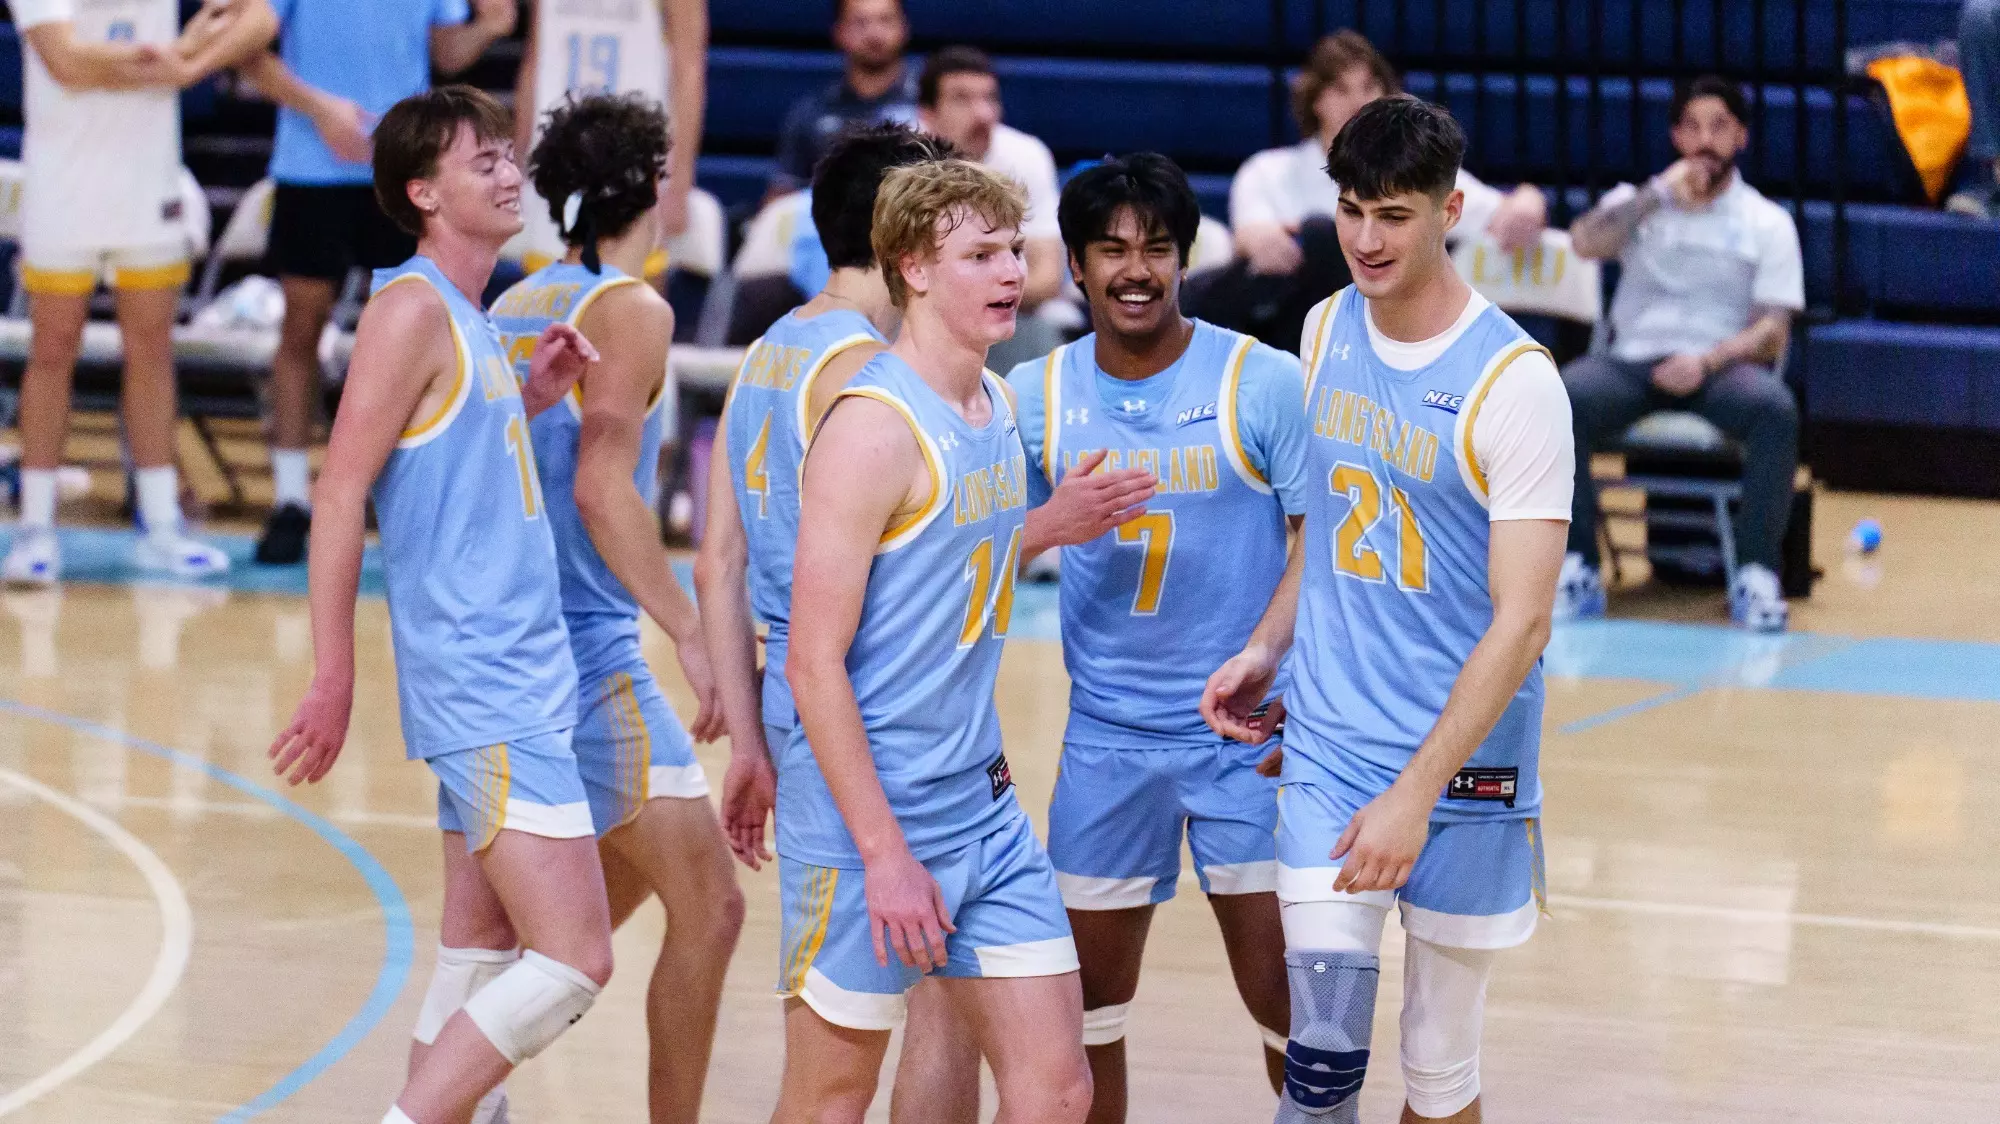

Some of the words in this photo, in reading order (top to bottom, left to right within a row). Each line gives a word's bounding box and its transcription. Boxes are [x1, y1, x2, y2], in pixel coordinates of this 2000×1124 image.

[566, 33, 619, 96] 19
[1176, 401, 1217, 425] NEC
[1314, 386, 1369, 446] LONG
[1422, 389, 1465, 410] NEC
[745, 406, 771, 519] 4
[1328, 460, 1430, 593] 21
[1114, 509, 1176, 616] 7
